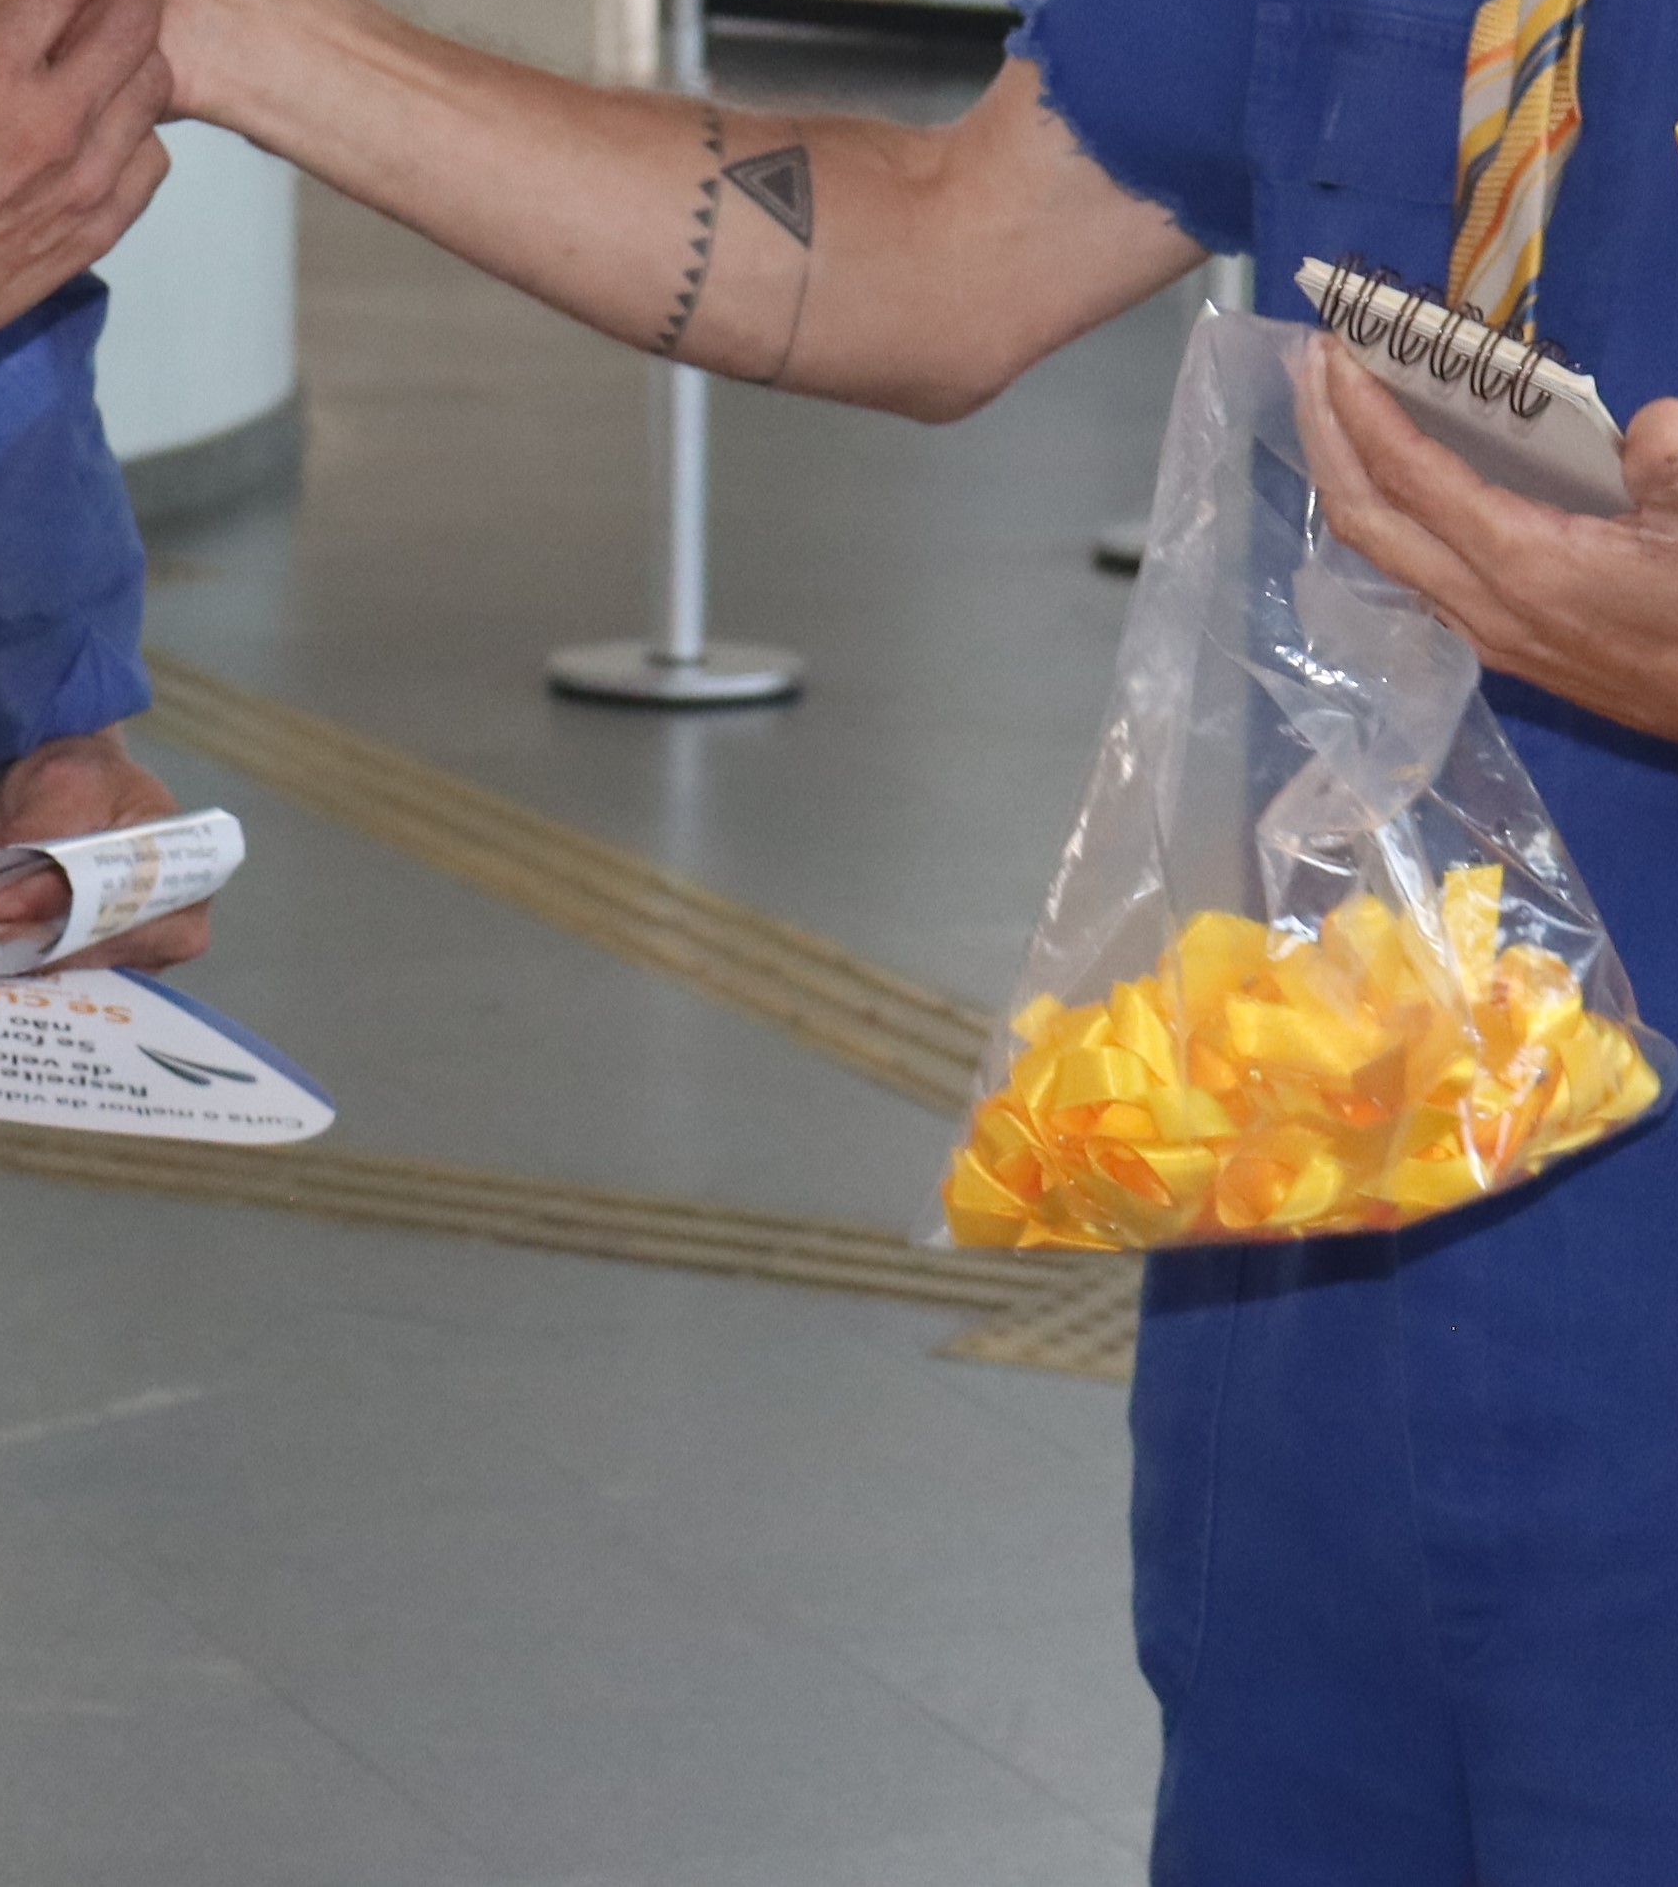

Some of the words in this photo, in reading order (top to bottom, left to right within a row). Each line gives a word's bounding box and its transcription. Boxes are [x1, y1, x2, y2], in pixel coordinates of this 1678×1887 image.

[8, 1015, 72, 1032] não
[57, 1037, 96, 1050] Se
[70, 1061, 112, 1074] de
[0, 1066, 149, 1096] Respeite
[54, 1095, 89, 1108] da
[96, 1101, 195, 1118] melhor
[228, 1113, 305, 1128] Curta
